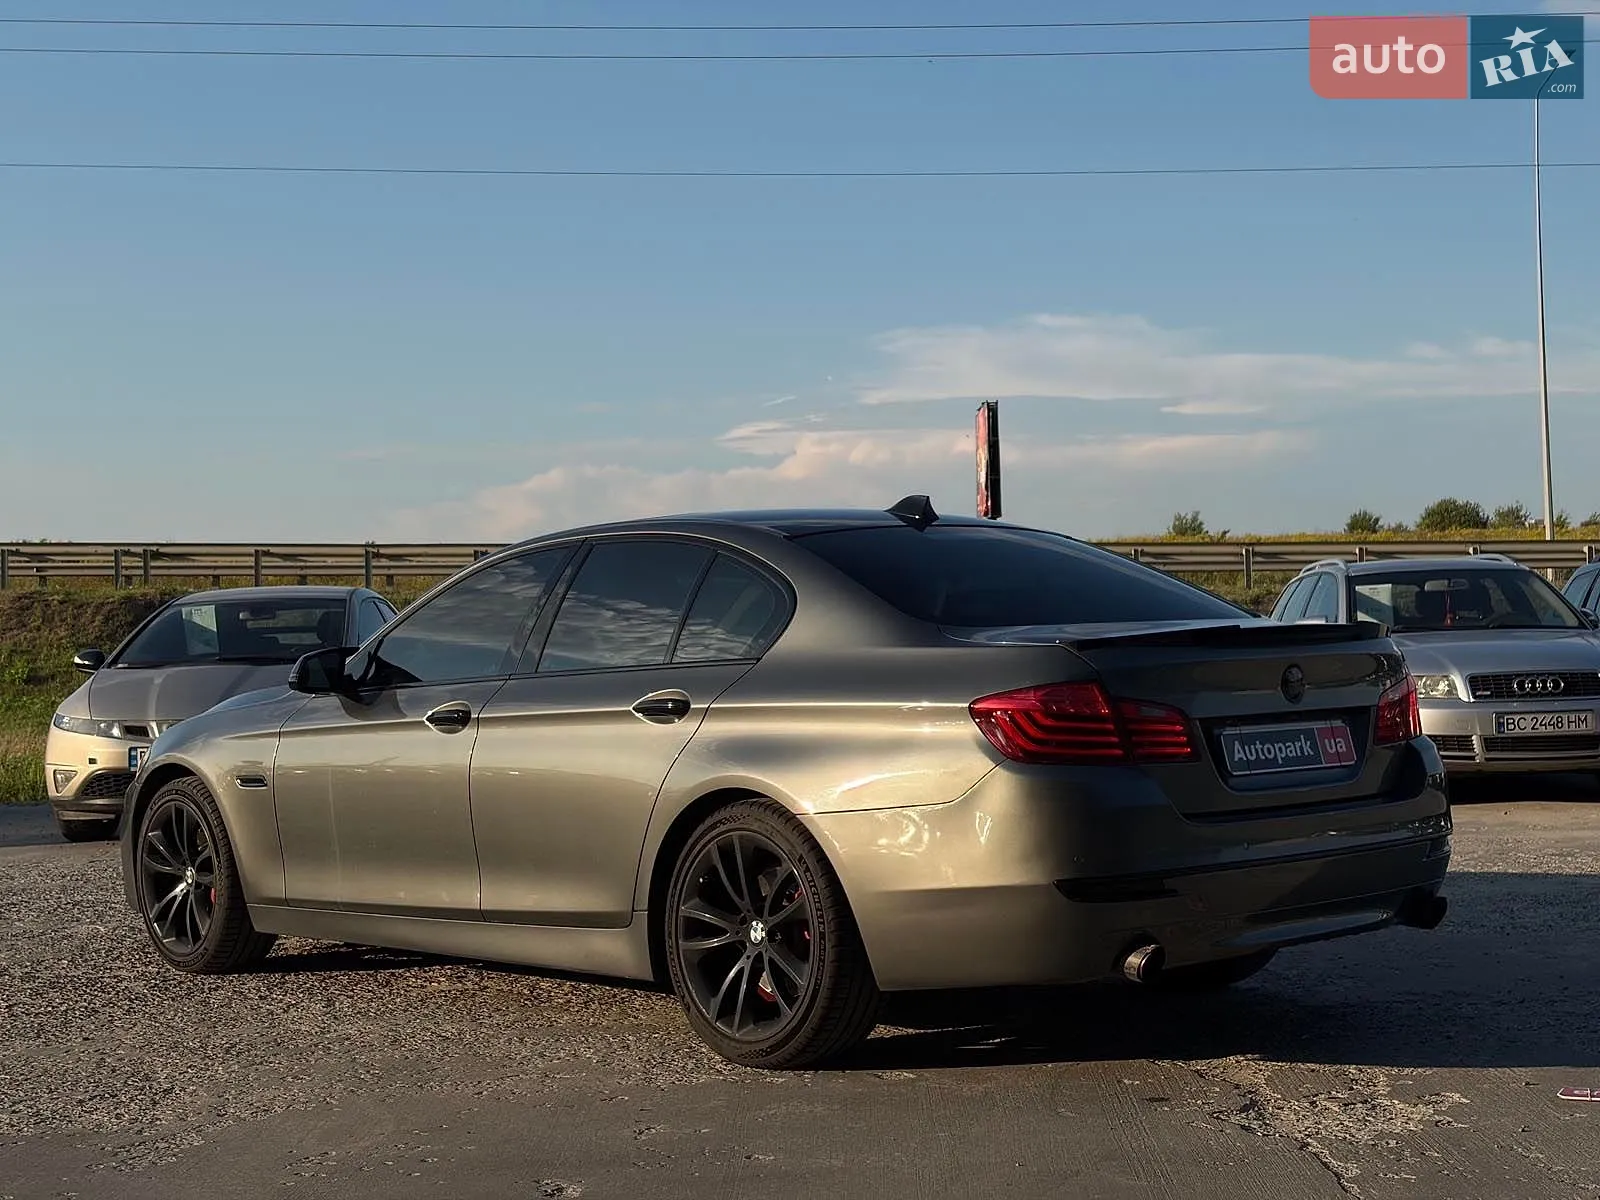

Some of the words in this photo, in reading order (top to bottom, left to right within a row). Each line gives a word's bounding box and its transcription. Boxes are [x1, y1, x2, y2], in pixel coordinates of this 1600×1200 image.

[1506, 717, 1527, 732] BC
[1531, 715, 1563, 730] 2448
[1567, 714, 1588, 729] HM
[1234, 734, 1314, 764] Autopark
[805, 872, 826, 933] MICHELIN
